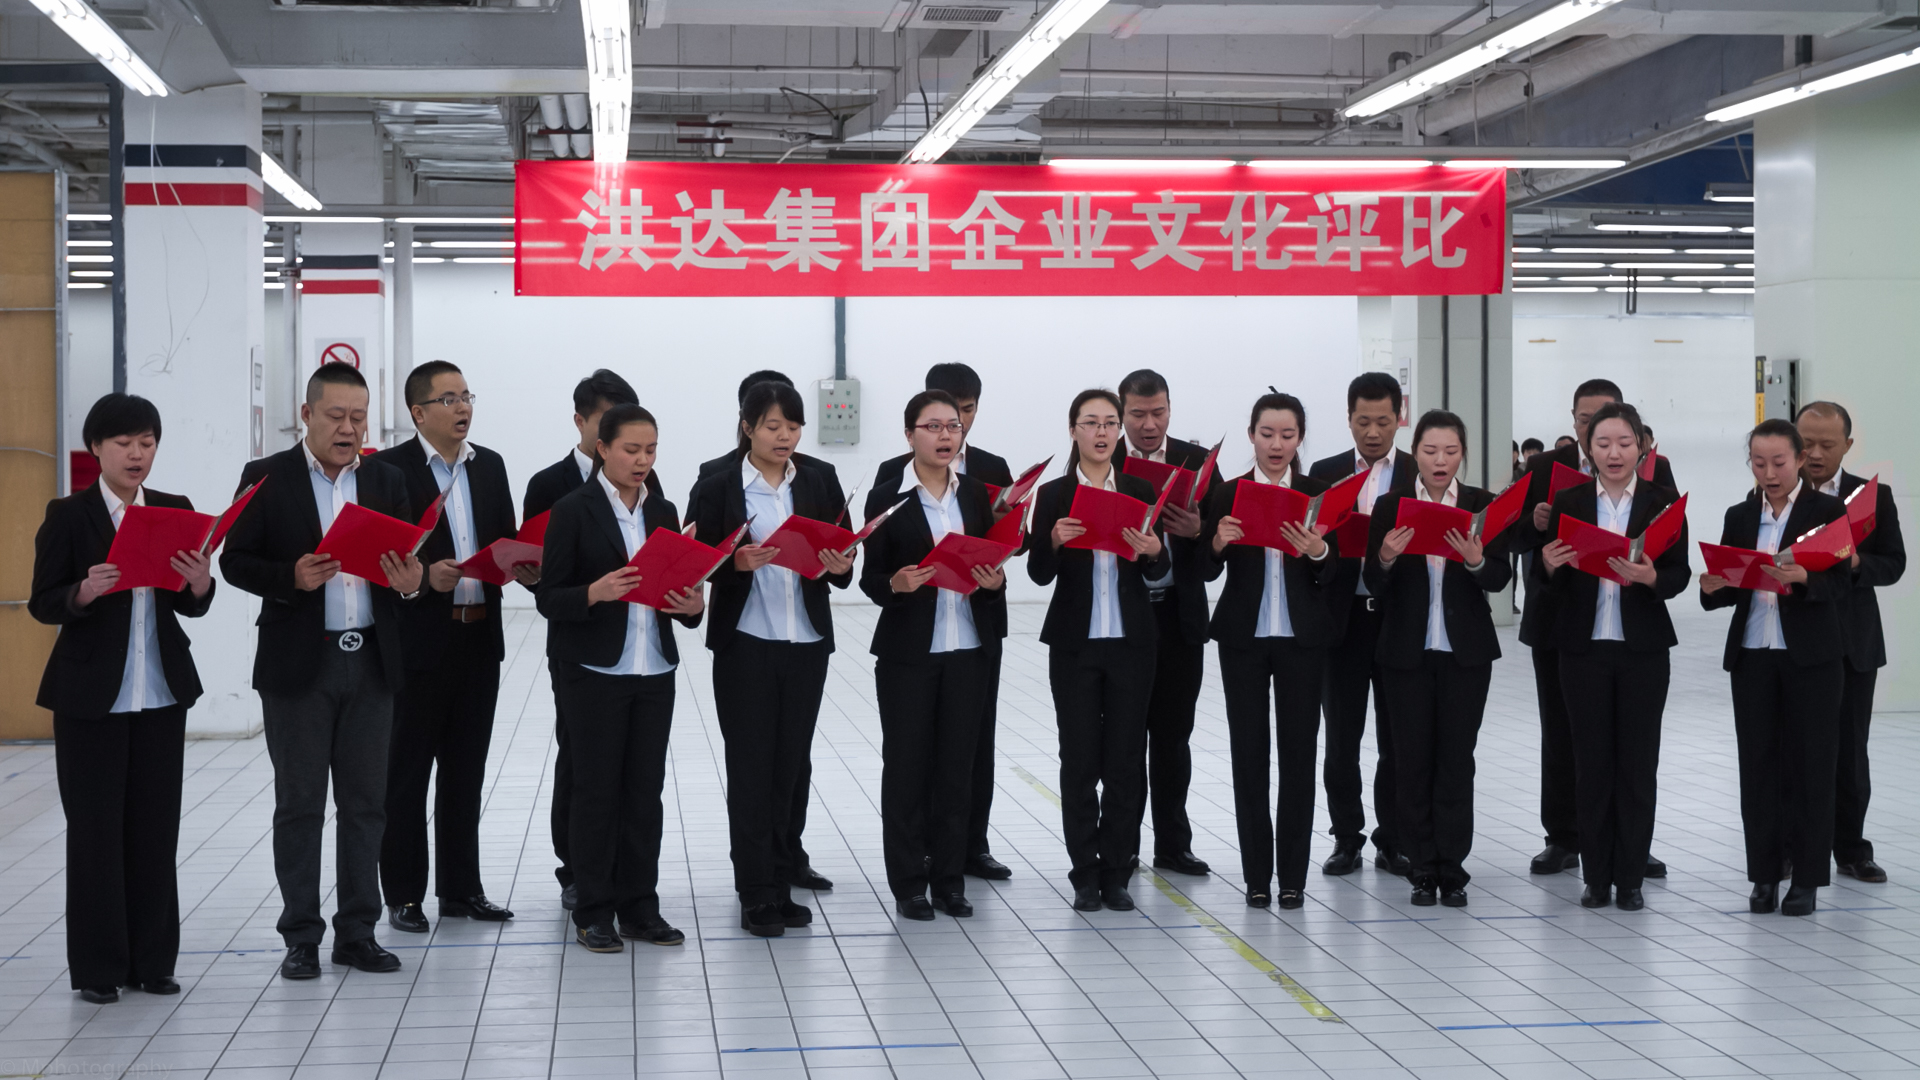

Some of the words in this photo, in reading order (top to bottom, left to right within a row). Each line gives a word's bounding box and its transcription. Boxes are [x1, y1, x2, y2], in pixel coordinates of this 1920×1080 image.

[577, 187, 1467, 272] 洪达集团企业文化评比
